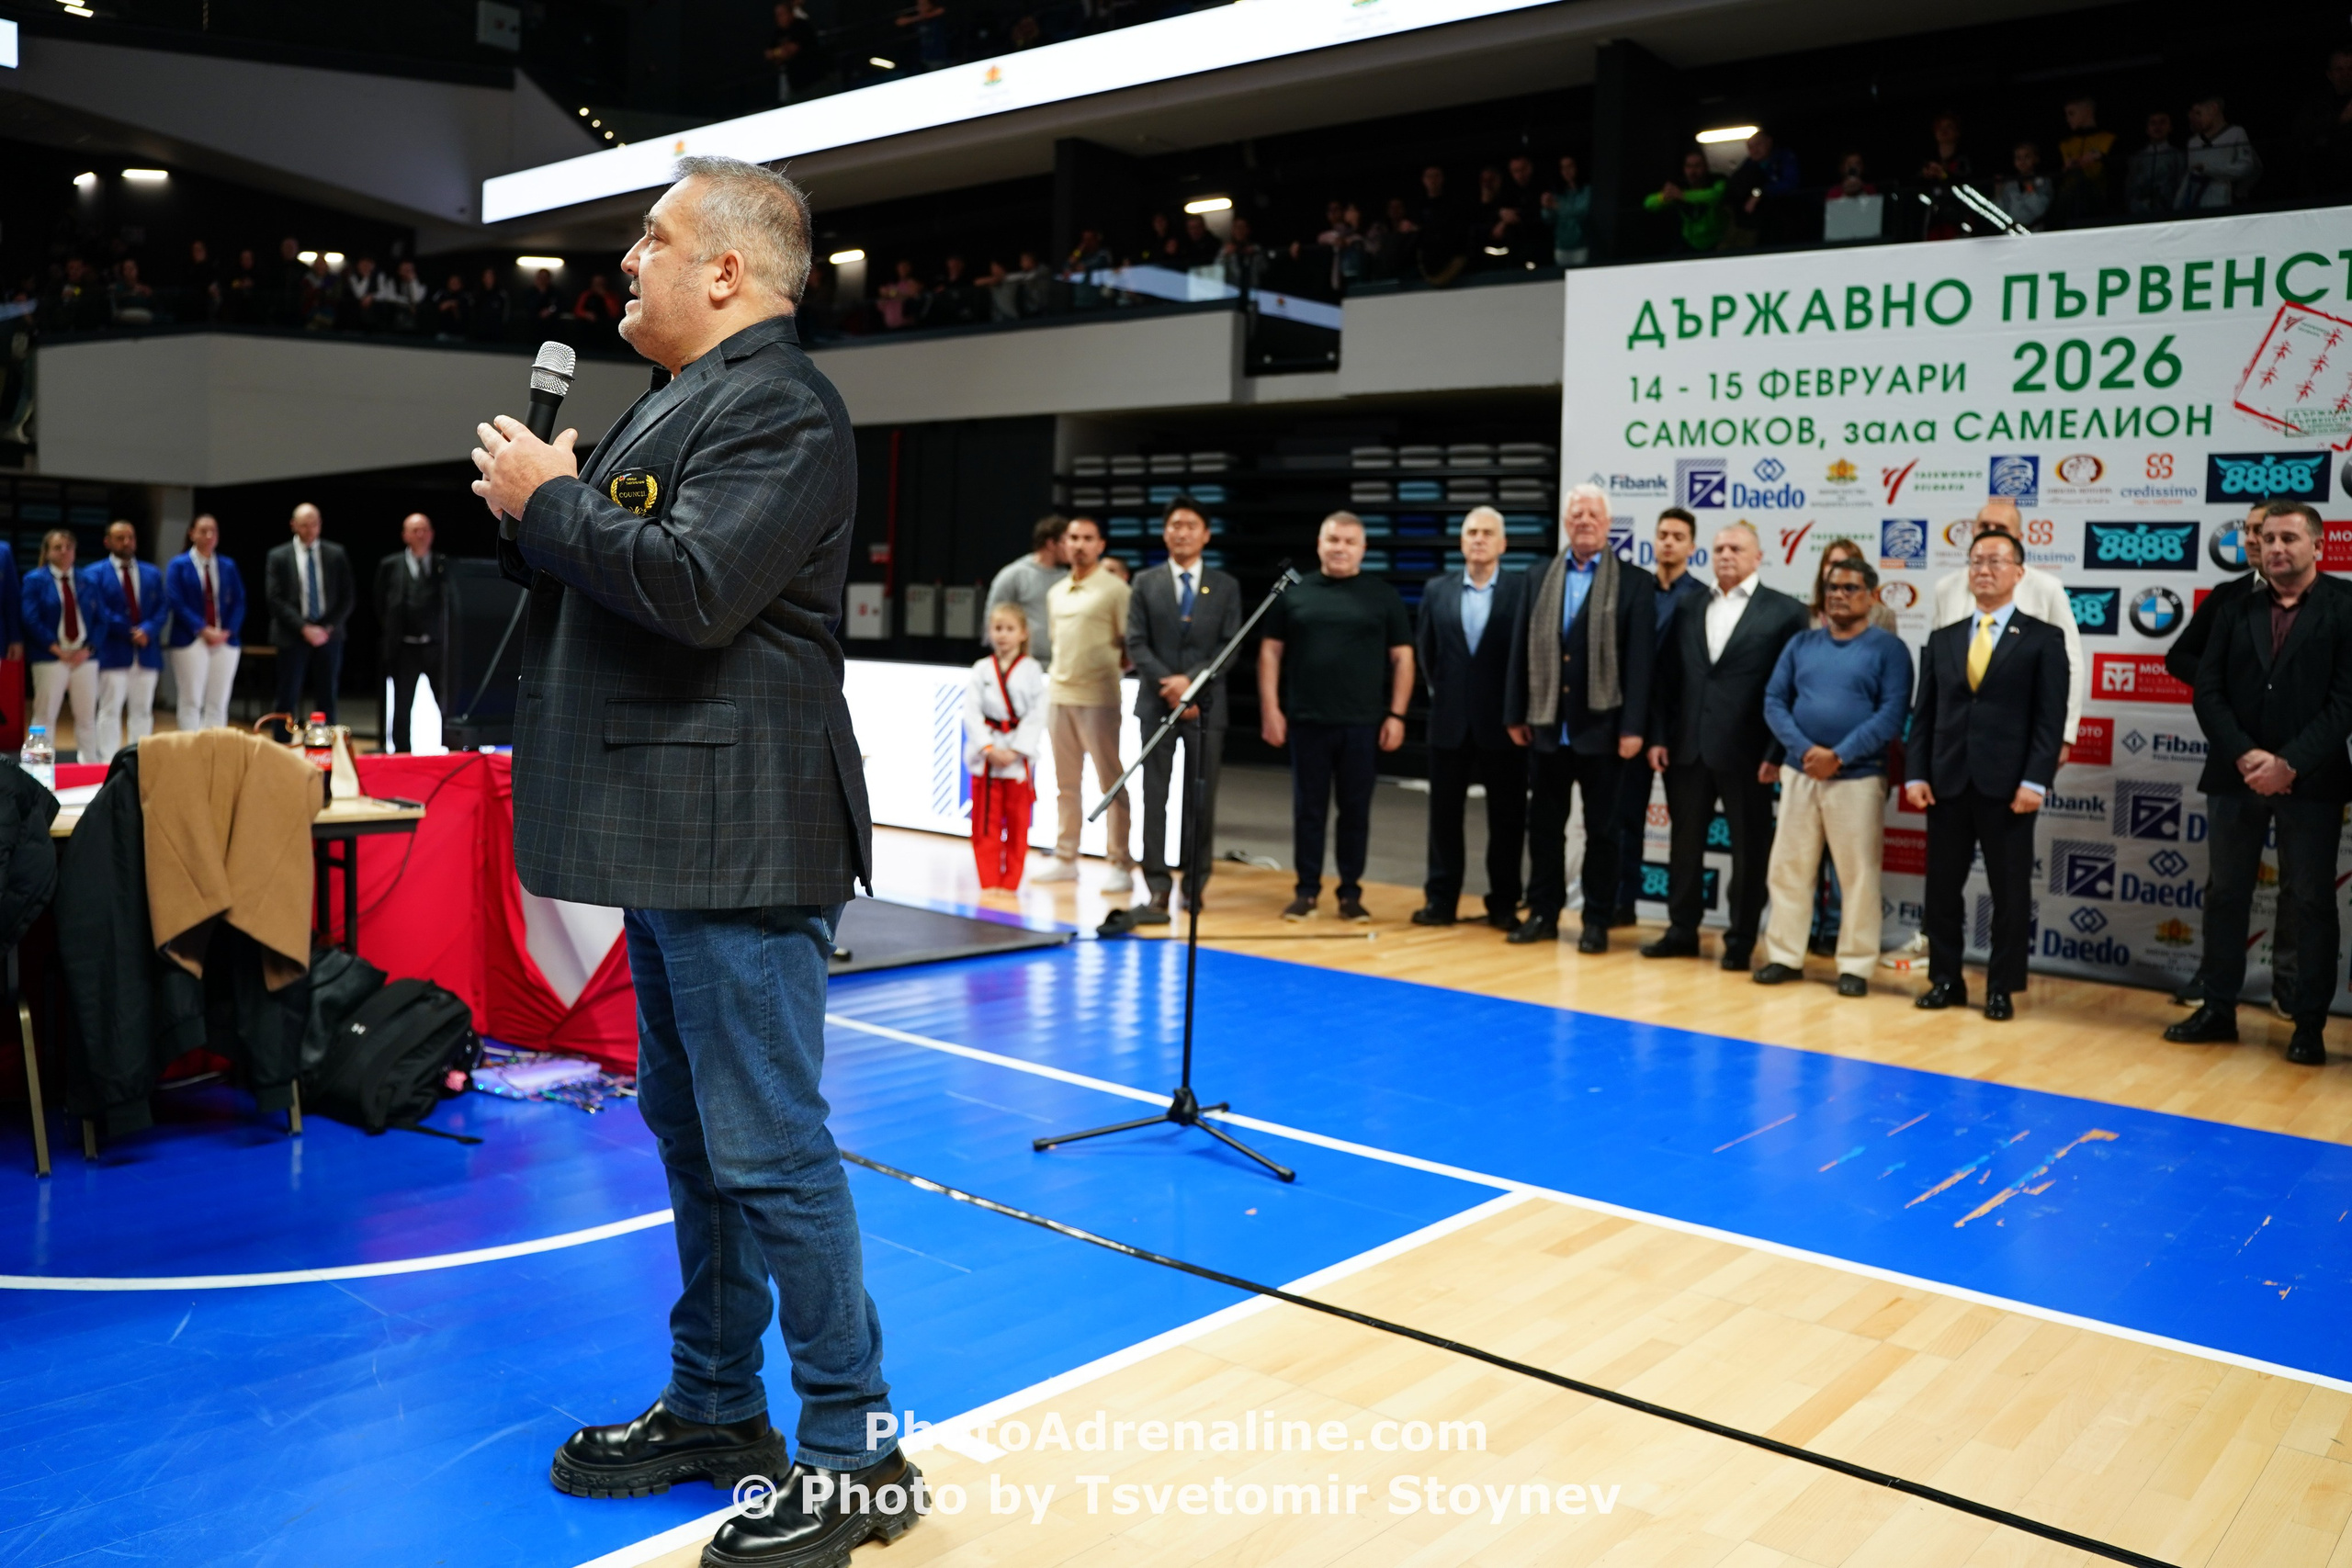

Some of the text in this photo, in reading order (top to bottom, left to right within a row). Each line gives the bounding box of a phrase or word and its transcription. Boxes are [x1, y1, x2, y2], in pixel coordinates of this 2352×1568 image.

[1627, 278, 1972, 350] ДЪРЖАВНО
[1630, 376, 1663, 402] 14
[1710, 372, 1743, 400] 15
[1758, 362, 1966, 400] ФЕВРУАРИ
[2012, 334, 2183, 393] 2026
[1624, 404, 2212, 449] САМОКОВ, зала САМЕЛИОН
[1610, 473, 1668, 490] Fibank
[2120, 484, 2198, 498] credissimo
[2221, 465, 2314, 494] 8888
[1733, 483, 1805, 509] Daedo
[2025, 551, 2076, 563] dissimo
[2097, 533, 2185, 562] 8888
[2154, 734, 2209, 753] Fiba
[2044, 791, 2106, 812] ibank
[2043, 929, 2131, 965] Daedo
